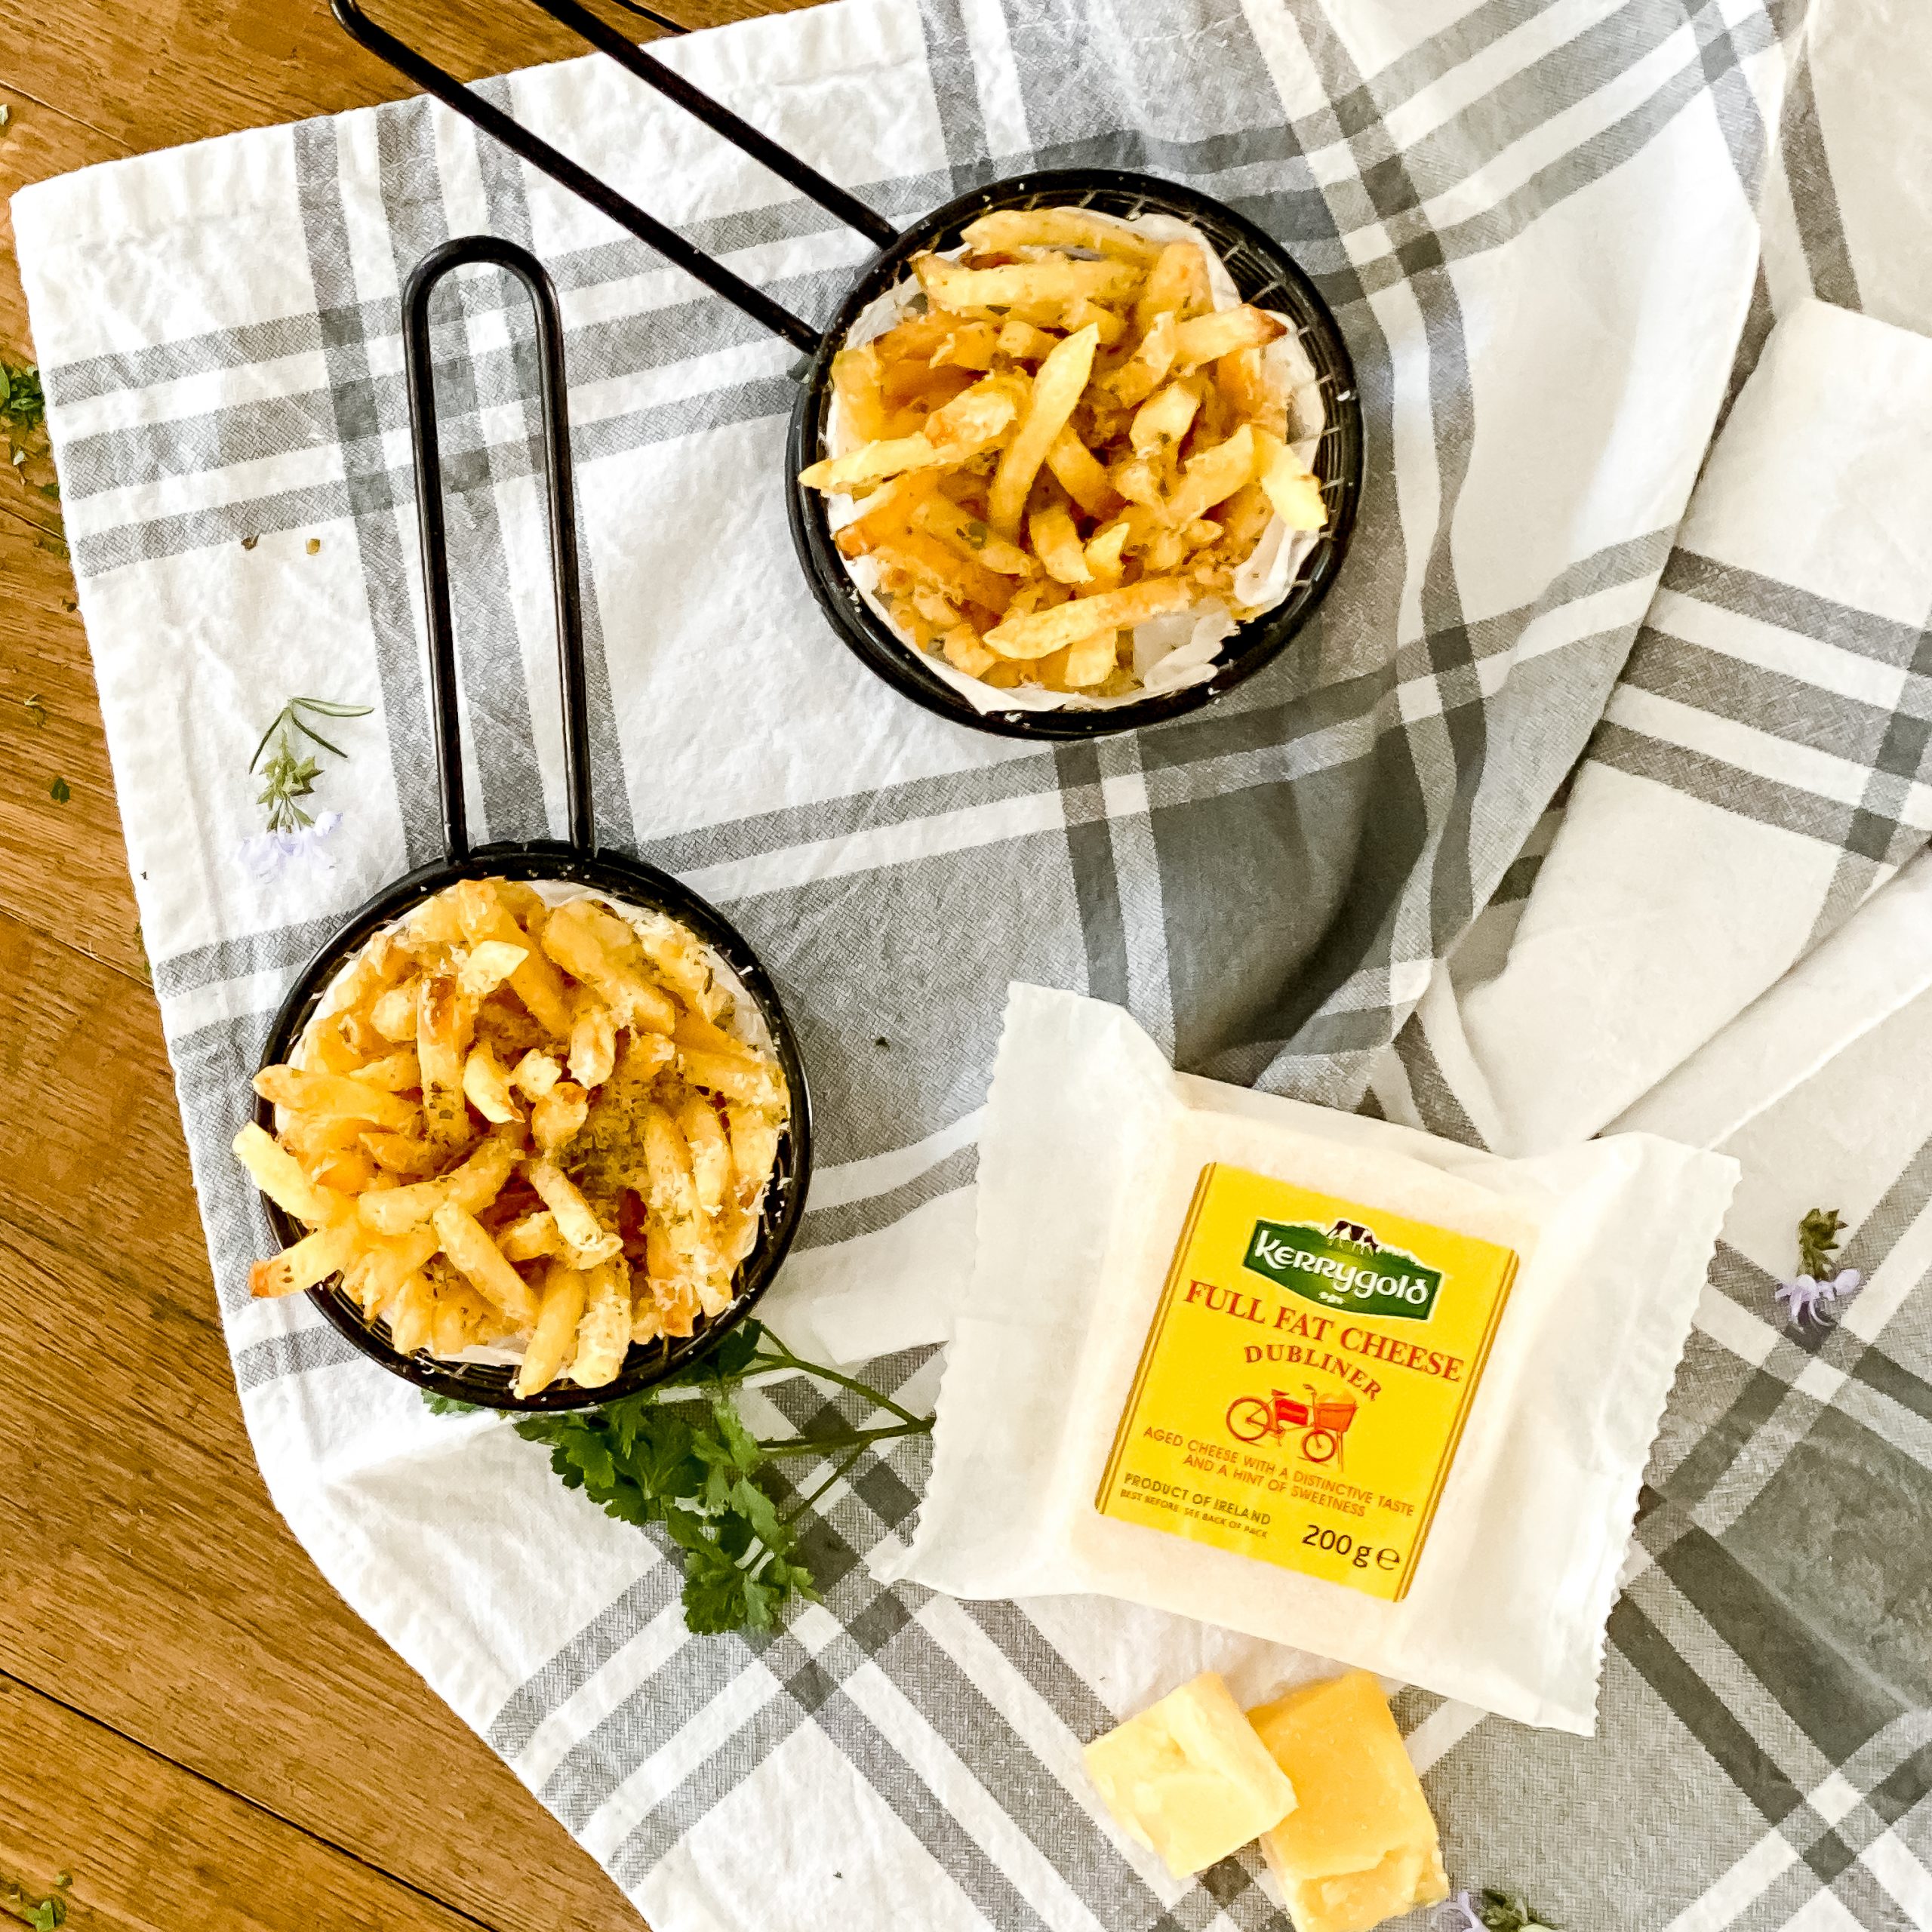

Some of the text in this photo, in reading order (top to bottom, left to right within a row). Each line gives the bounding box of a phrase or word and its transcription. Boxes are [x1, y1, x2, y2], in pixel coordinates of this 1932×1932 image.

[1183, 1279, 1464, 1383] FULL FAT CHEESE
[1244, 1344, 1381, 1401] DUBLINER
[1124, 1472, 1271, 1525] PRODUCT OF IRELAND
[1143, 1426, 1415, 1516] AGED CHEESE WITH A DISTINCTIVE TASTE
[1183, 1454, 1365, 1517] AND A HINT OF SWEETNESS
[1120, 1488, 1143, 1501] BEST
[1201, 1513, 1227, 1526] BACK
